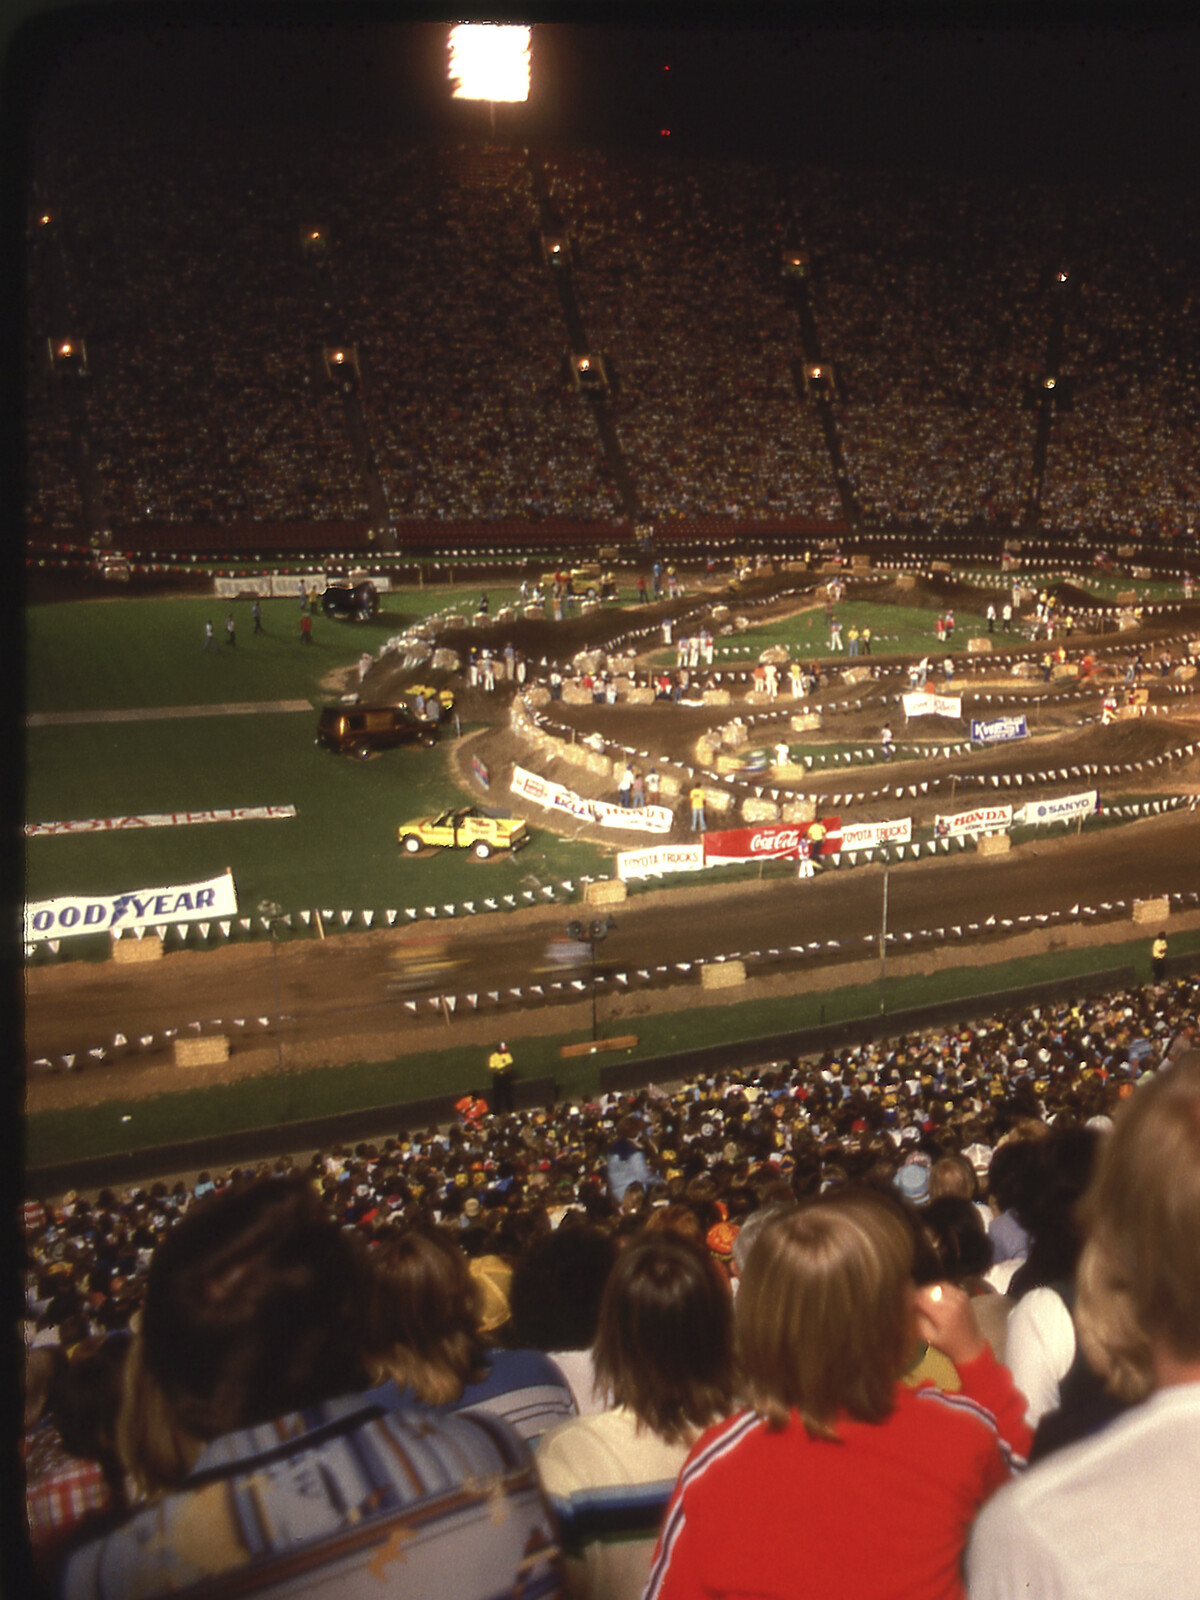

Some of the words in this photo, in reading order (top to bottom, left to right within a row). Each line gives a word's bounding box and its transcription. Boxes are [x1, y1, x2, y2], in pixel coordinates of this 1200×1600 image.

[1049, 799, 1089, 814] SANYO
[954, 810, 1007, 826] HONDA
[843, 830, 872, 843] TOYOTA
[876, 824, 908, 841] TRUCKS
[624, 854, 658, 869] TOYOTA
[662, 851, 699, 864] TRUCKS
